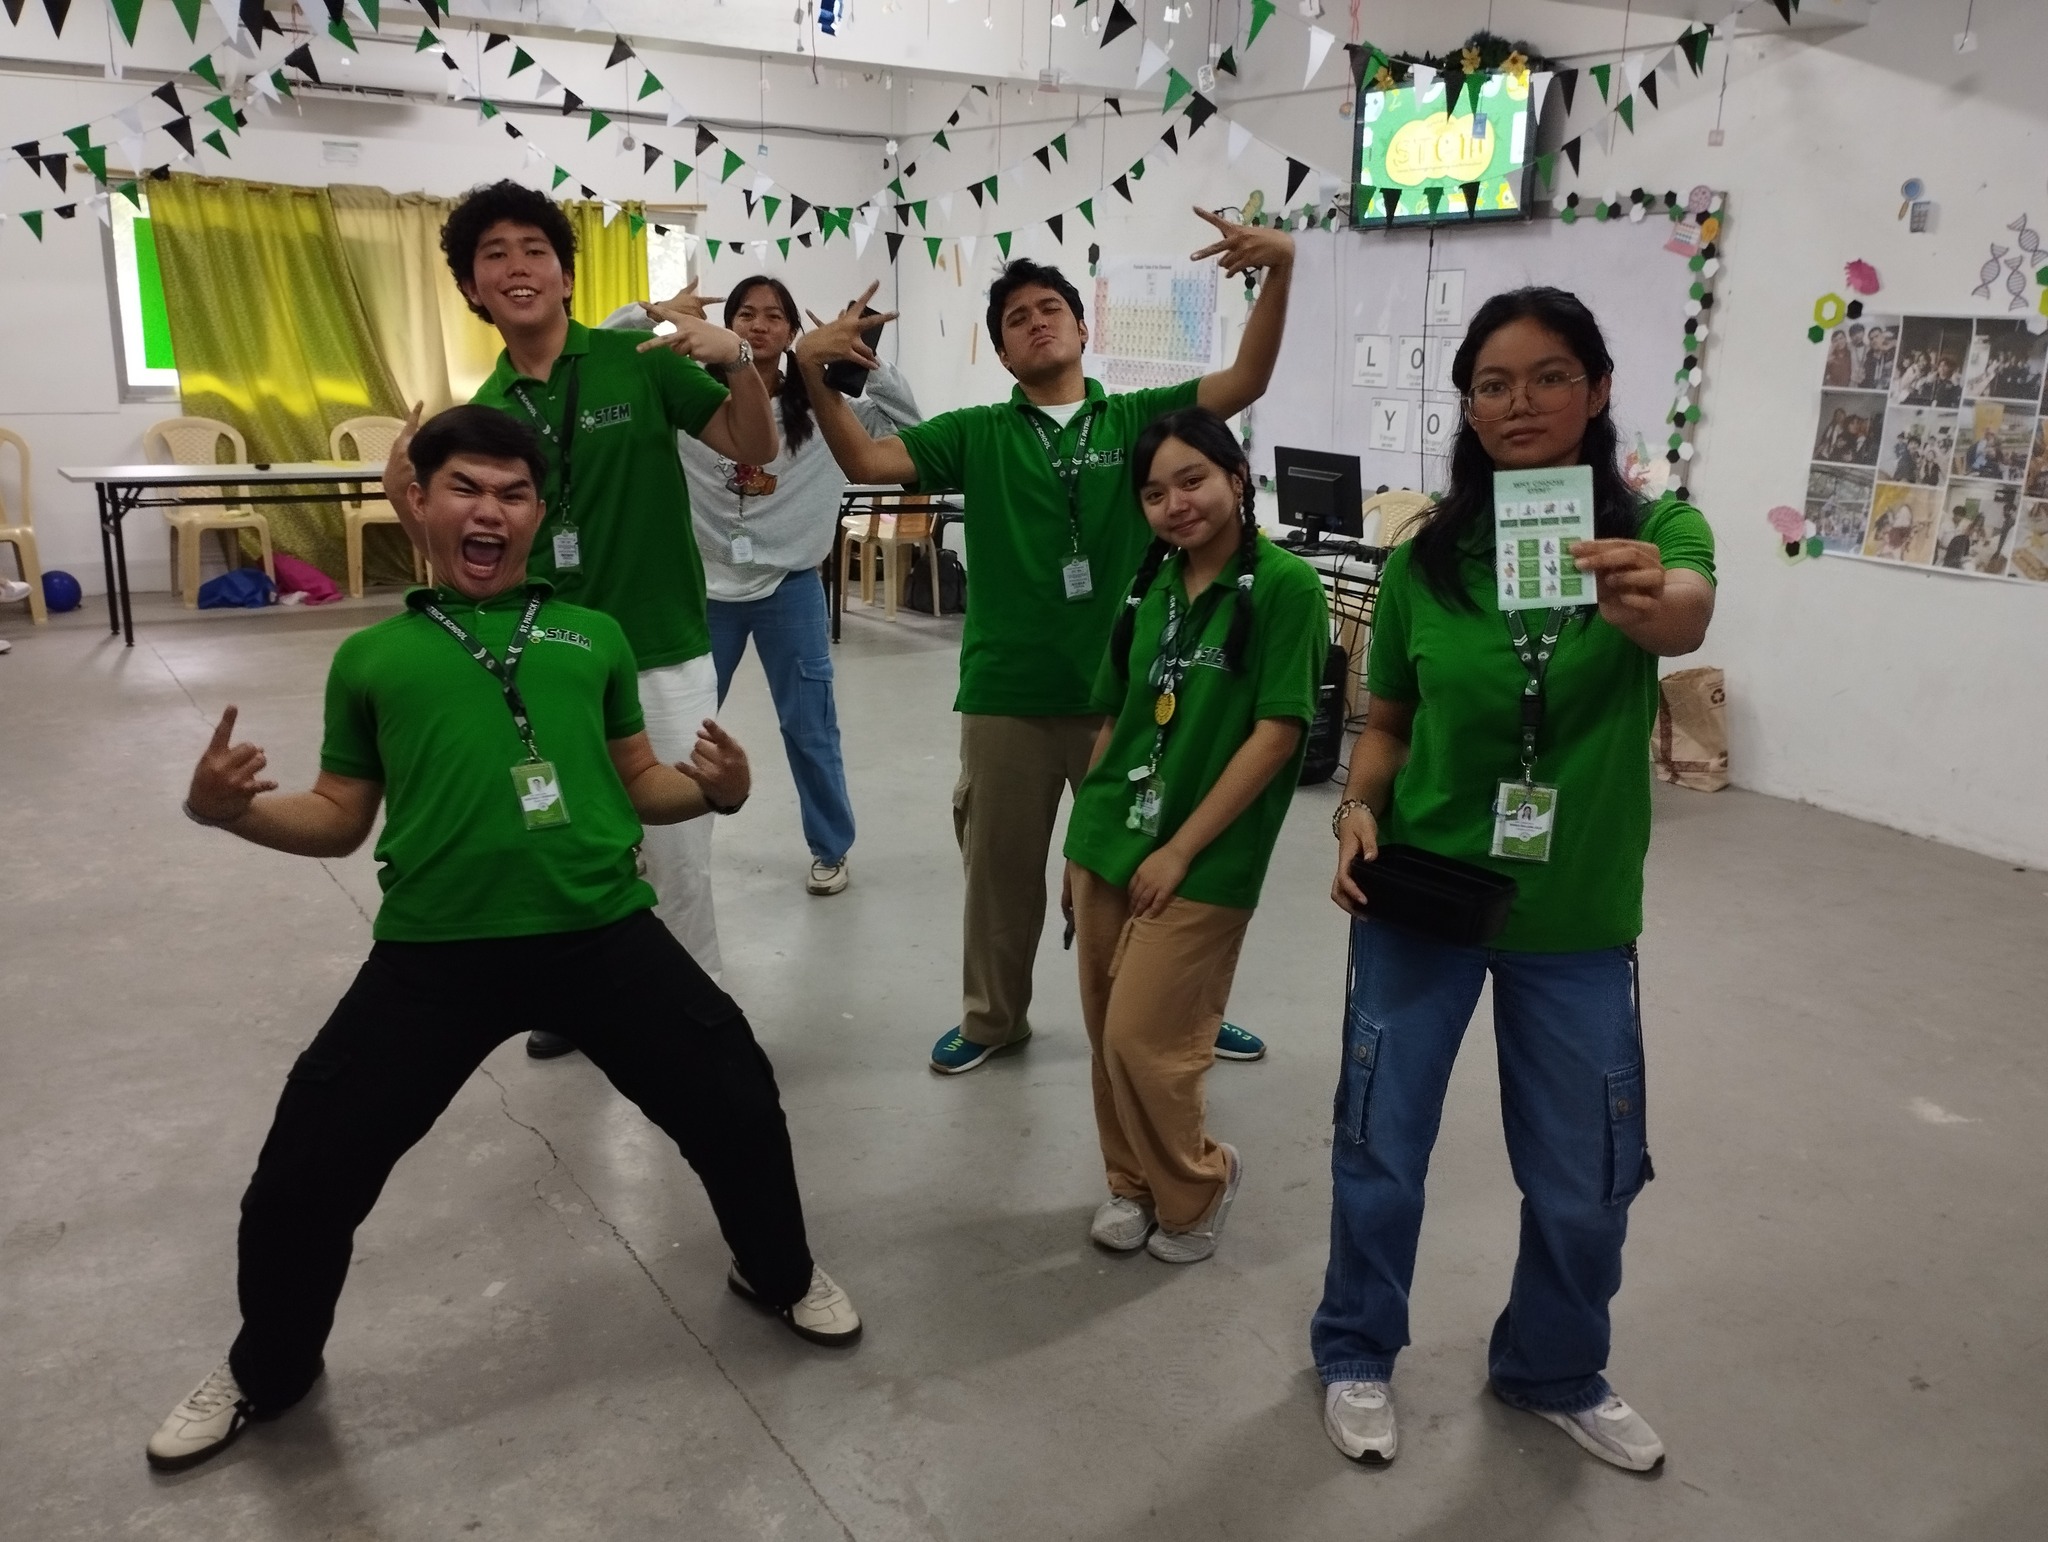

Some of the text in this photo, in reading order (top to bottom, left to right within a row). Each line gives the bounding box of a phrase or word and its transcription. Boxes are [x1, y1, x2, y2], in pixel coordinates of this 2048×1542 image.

[1441, 282, 1447, 305] I
[1366, 345, 1424, 370] L O
[594, 402, 631, 425] STEM
[1384, 409, 1440, 435] Y O
[1081, 415, 1092, 437] PATRIC
[1036, 427, 1051, 450] SCHOOL
[522, 602, 538, 625] PATRICK
[442, 619, 468, 641] SCHOOL
[545, 627, 592, 648] STEM
